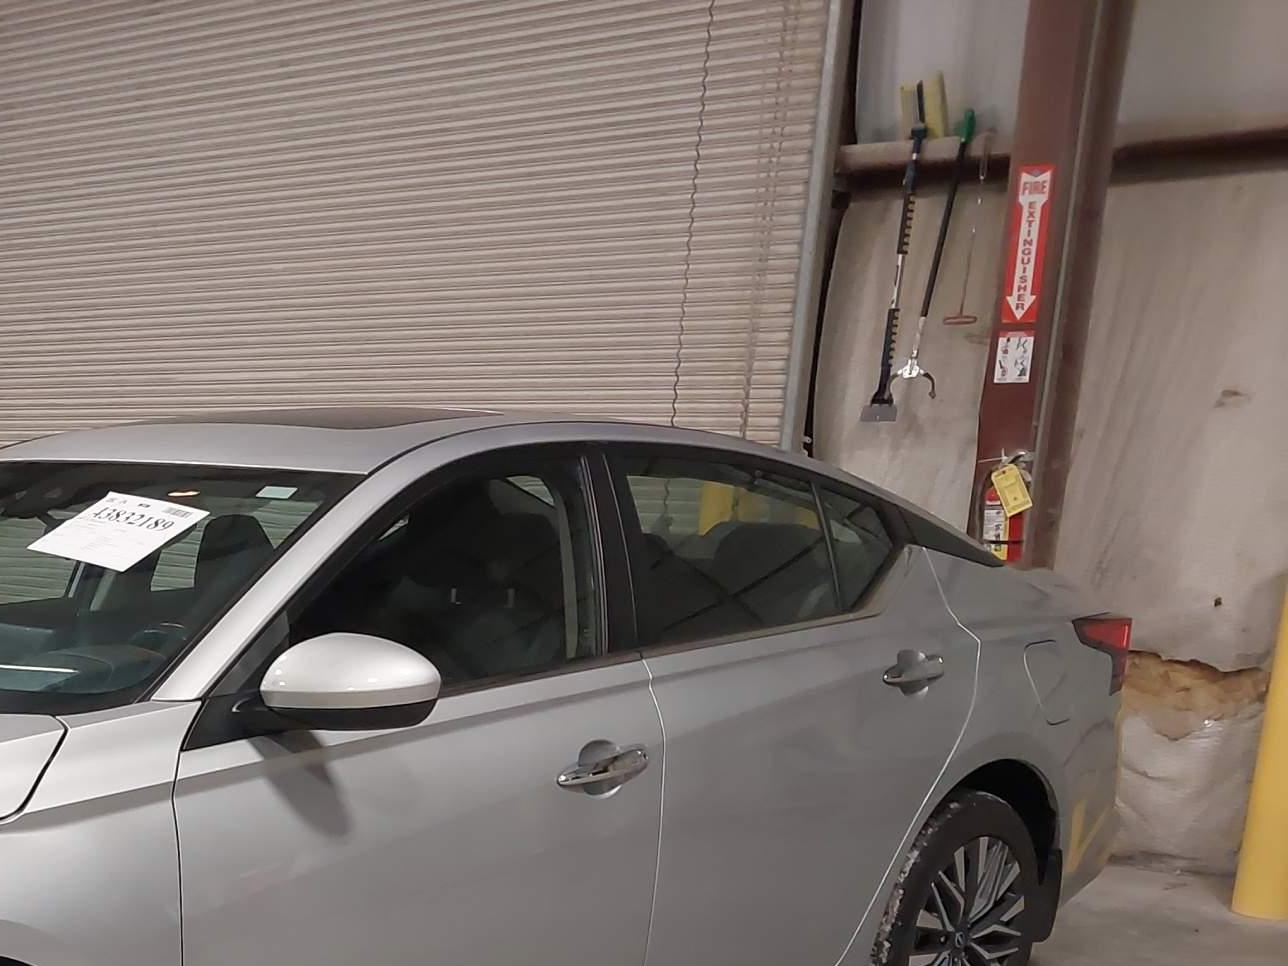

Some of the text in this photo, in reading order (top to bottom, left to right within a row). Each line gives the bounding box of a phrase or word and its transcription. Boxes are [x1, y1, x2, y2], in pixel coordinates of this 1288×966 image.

[1022, 181, 1048, 195] FIRE
[1015, 201, 1037, 311] EXTINGUISHER
[93, 507, 175, 531] 43832189
